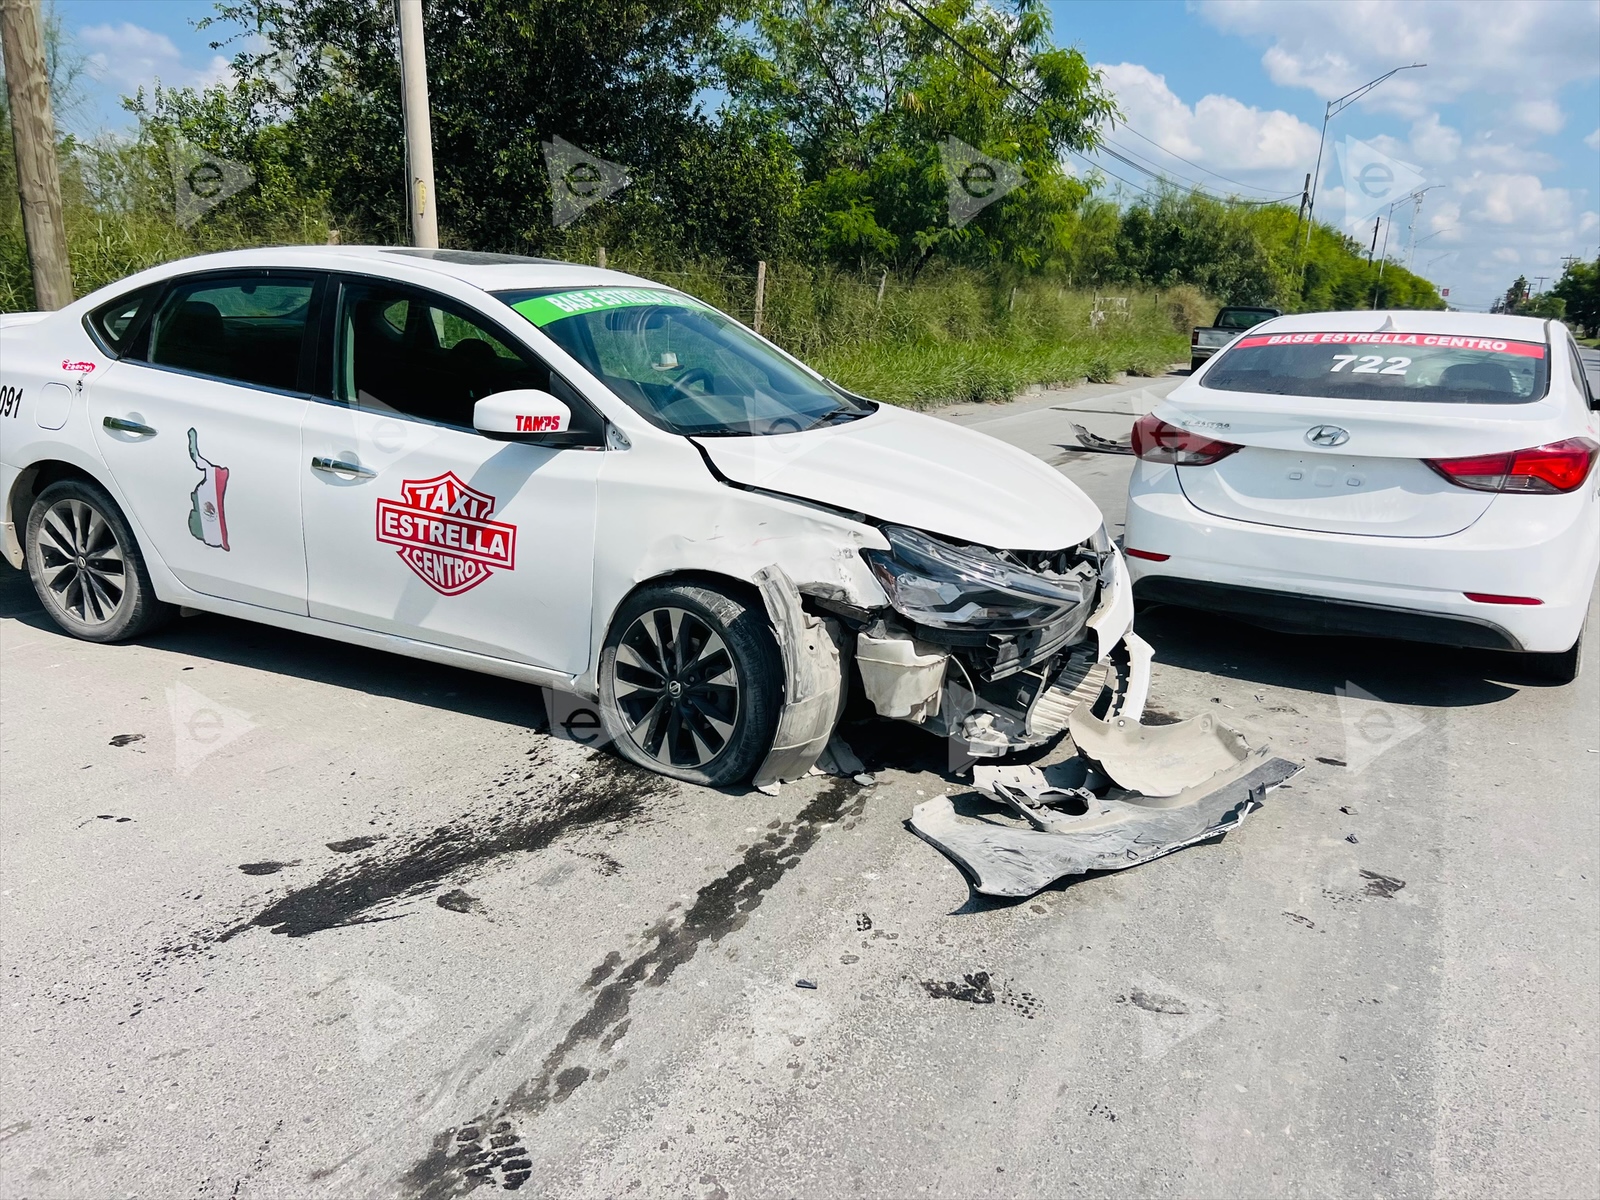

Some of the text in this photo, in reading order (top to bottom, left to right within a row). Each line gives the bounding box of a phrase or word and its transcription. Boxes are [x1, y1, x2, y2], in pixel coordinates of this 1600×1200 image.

[545, 291, 604, 313] BASE
[594, 289, 667, 305] ESTRELLA
[1267, 332, 1508, 351] BASE ESTRELLA CENTRO
[1329, 354, 1412, 376] 722
[516, 415, 560, 431] TAMPS
[415, 483, 479, 519] TAXI
[385, 511, 506, 558] ESTRELLA
[412, 549, 476, 586] CENTRO
